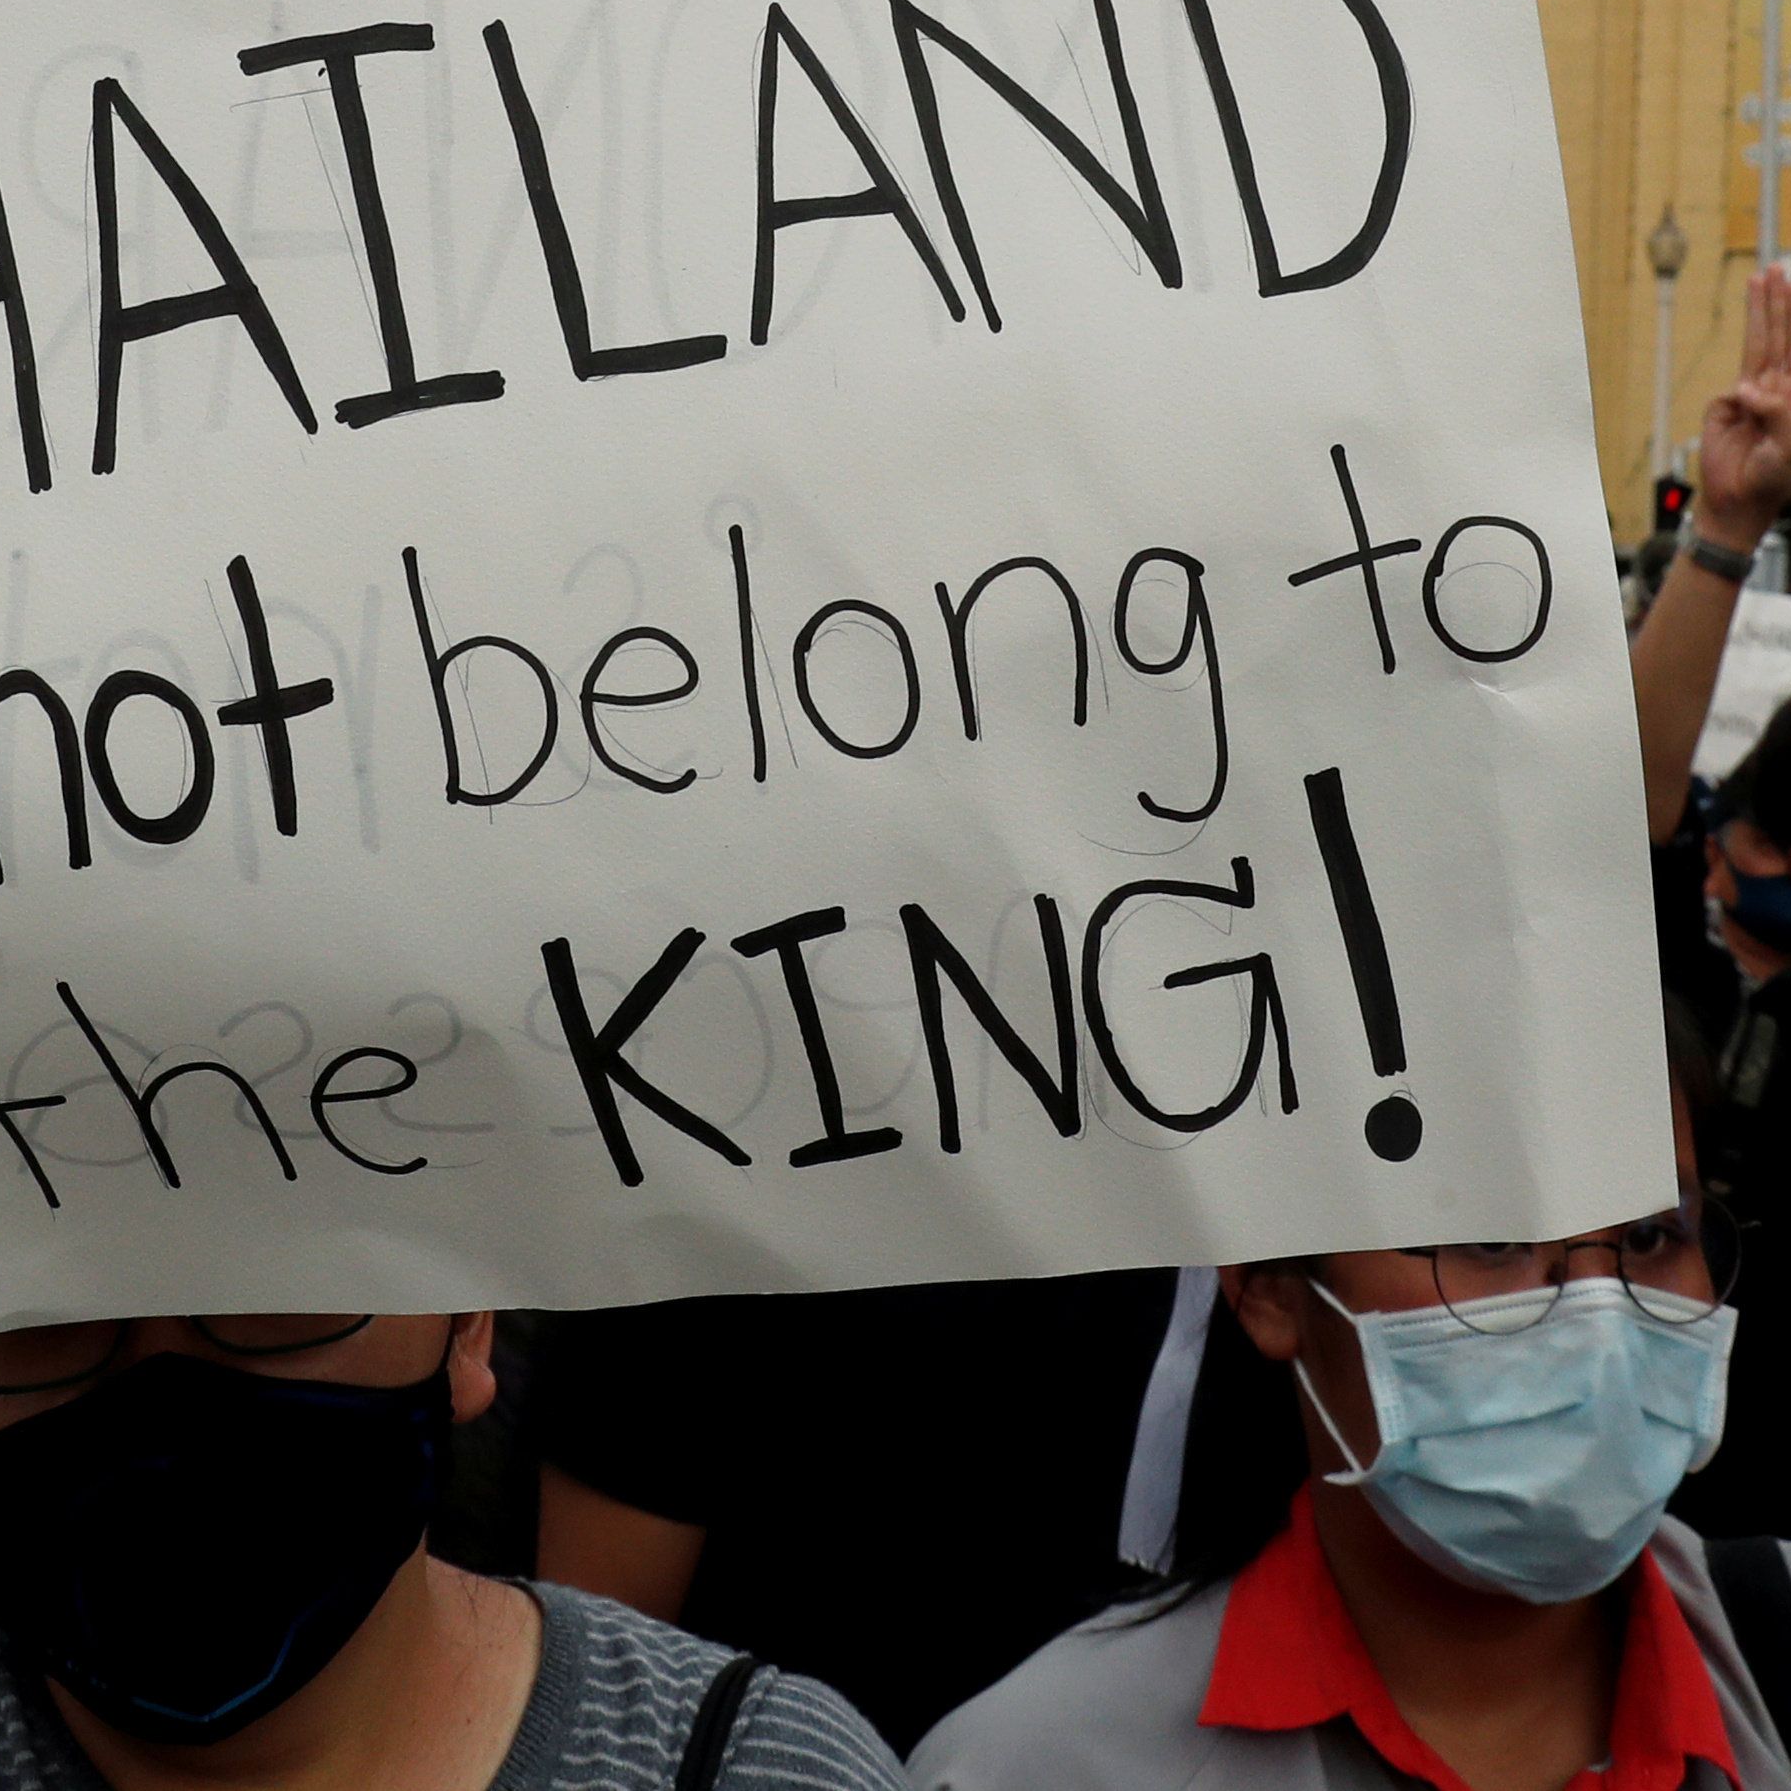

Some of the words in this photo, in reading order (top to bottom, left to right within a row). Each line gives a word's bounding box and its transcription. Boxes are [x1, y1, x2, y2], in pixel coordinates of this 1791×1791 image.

[402, 517, 1228, 822] belong
[1288, 445, 1552, 674] to
[541, 767, 1422, 1187] KING!
